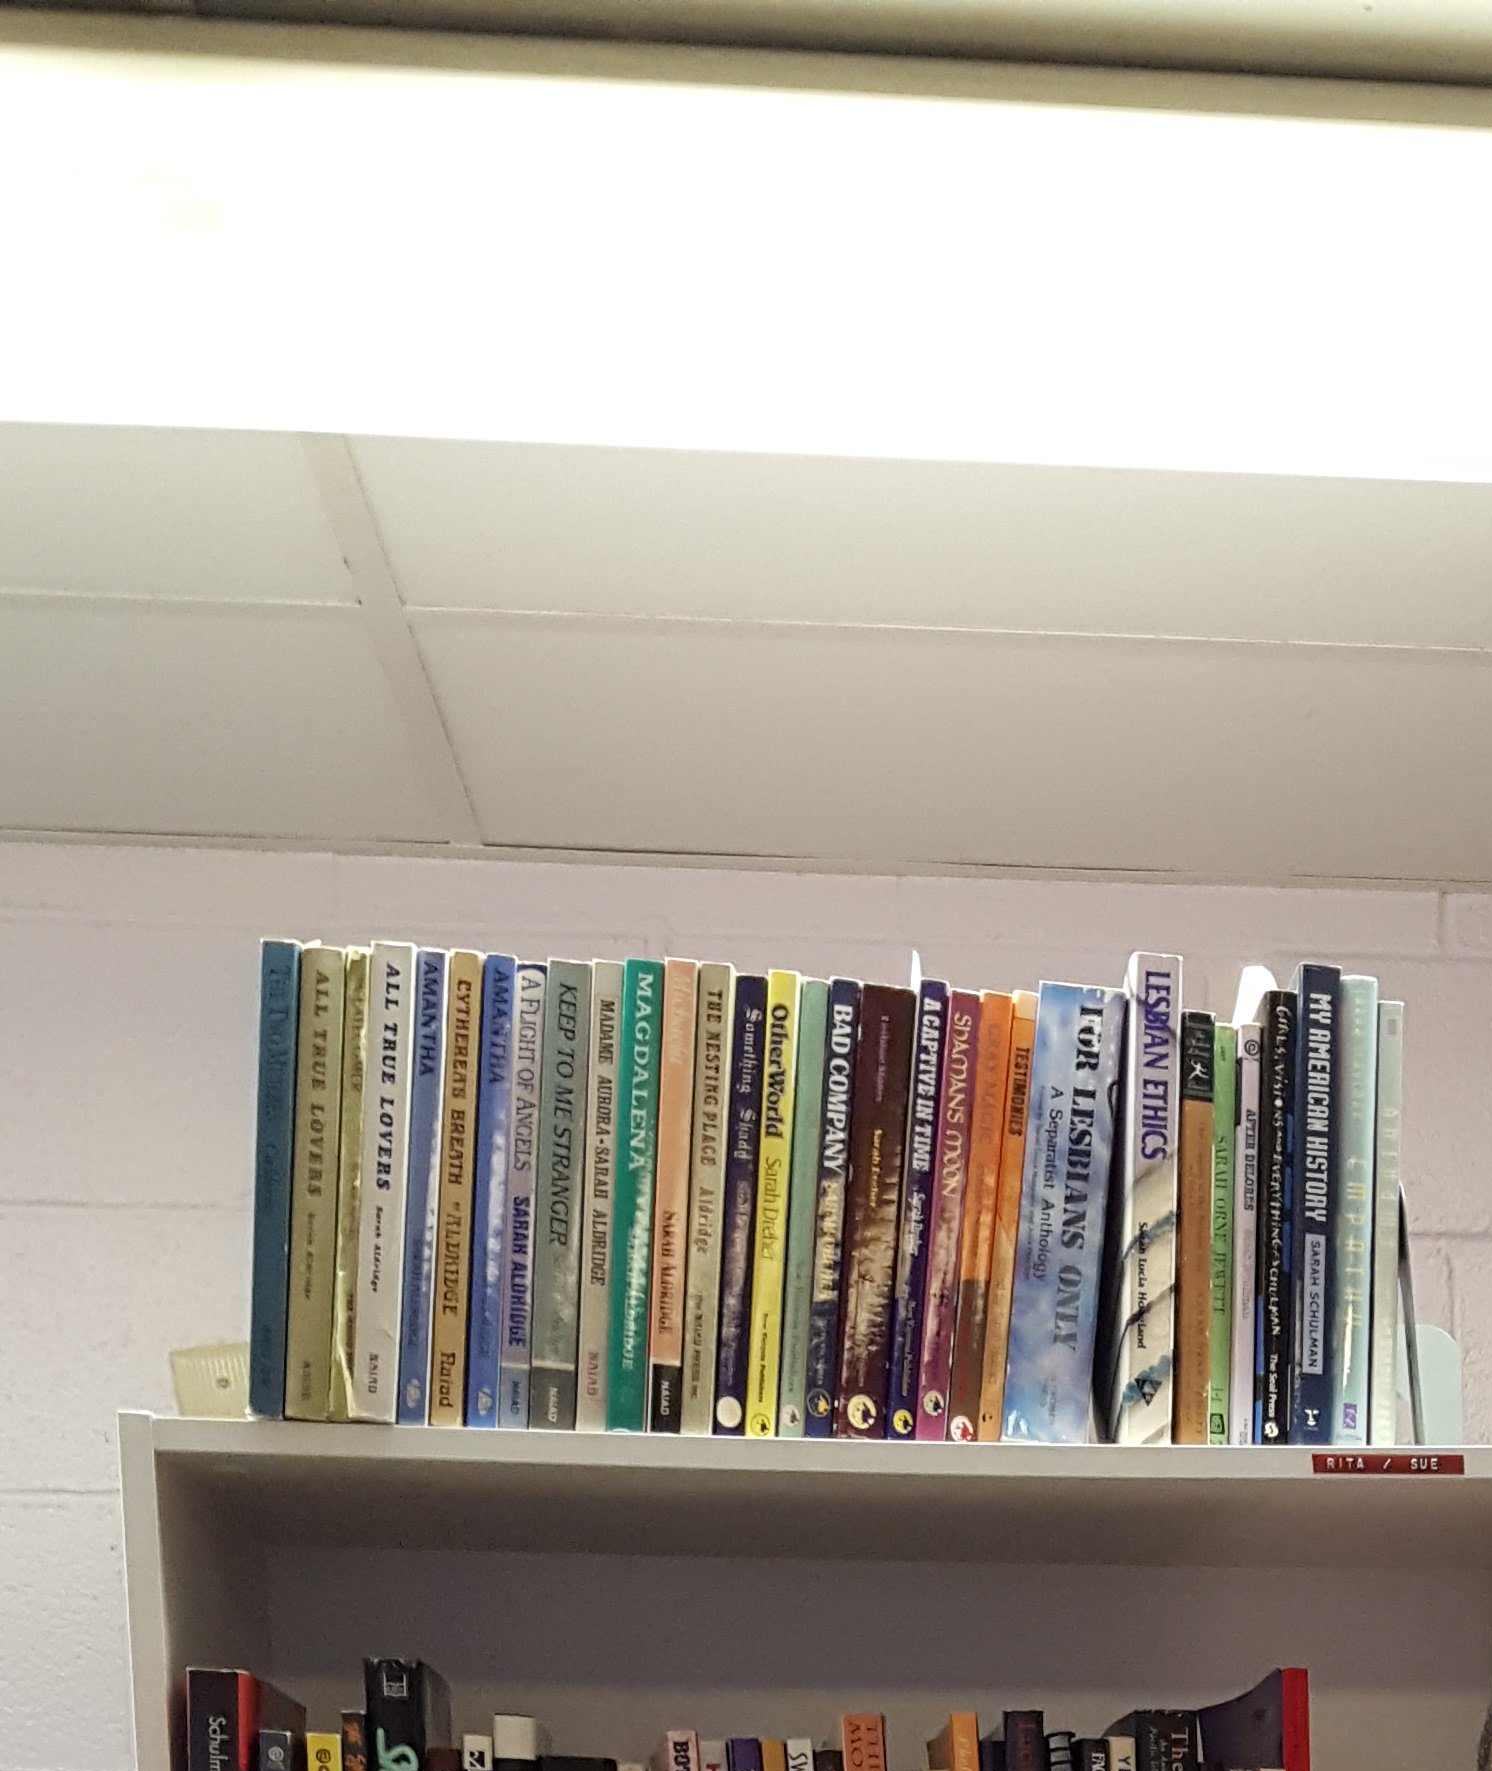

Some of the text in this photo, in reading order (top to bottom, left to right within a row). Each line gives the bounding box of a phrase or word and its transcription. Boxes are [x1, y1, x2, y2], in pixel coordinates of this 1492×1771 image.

[419, 960, 439, 1075] AMANTHA
[488, 968, 509, 1083] AMANTHA
[556, 1048, 575, 1080] TO
[559, 982, 578, 1041] KEEP
[737, 1007, 761, 1093] Something
[1141, 970, 1171, 1160] LESBIAN ETHICS
[307, 970, 329, 1197] ALL TRUE LOVERS
[376, 962, 401, 1191] ALL TRUE LOVERS
[513, 976, 540, 1171] A FLIGHT OF ANGELS
[554, 1085, 572, 1119] ME
[628, 972, 655, 1171] MAGDALENA
[699, 989, 723, 1167] THE NESTING PLACE
[764, 1004, 788, 1139] OtherWorld
[822, 1004, 853, 1174] BAD COMPANY
[912, 998, 940, 1172] A CAPTIVE IN TIME
[1008, 1047, 1030, 1137] TESTIMONIES
[1051, 1086, 1063, 1099] A
[1305, 993, 1332, 1221] MY AMERICAN HISTORY
[448, 1109, 466, 1184] BREATH
[548, 1126, 571, 1246] STRANGER
[590, 1000, 615, 1286] MADAME ALDRIDGE
[1043, 1109, 1063, 1189] Separatist
[1053, 1006, 1104, 1351] FOR LESBIANS ONLY
[1214, 1136, 1228, 1242] SARAH ORNE
[1244, 1109, 1256, 1211] AFTER DELORES
[696, 1186, 715, 1256] Aldridge
[761, 1157, 782, 1260] Sarah Dreher
[1033, 1199, 1055, 1281] Anthology
[508, 1197, 530, 1346] SARAH ALDRIDGE
[658, 1210, 679, 1335] SARAH ALDRIDGE
[1138, 1259, 1147, 1287] Lucia
[1309, 1240, 1320, 1368] SARAH SCHULMAN
[660, 1380, 671, 1416] NAIAD
[1267, 1354, 1279, 1418] The Seal Press
[1325, 1457, 1363, 1470] RITA
[1410, 1457, 1439, 1471] SUE
